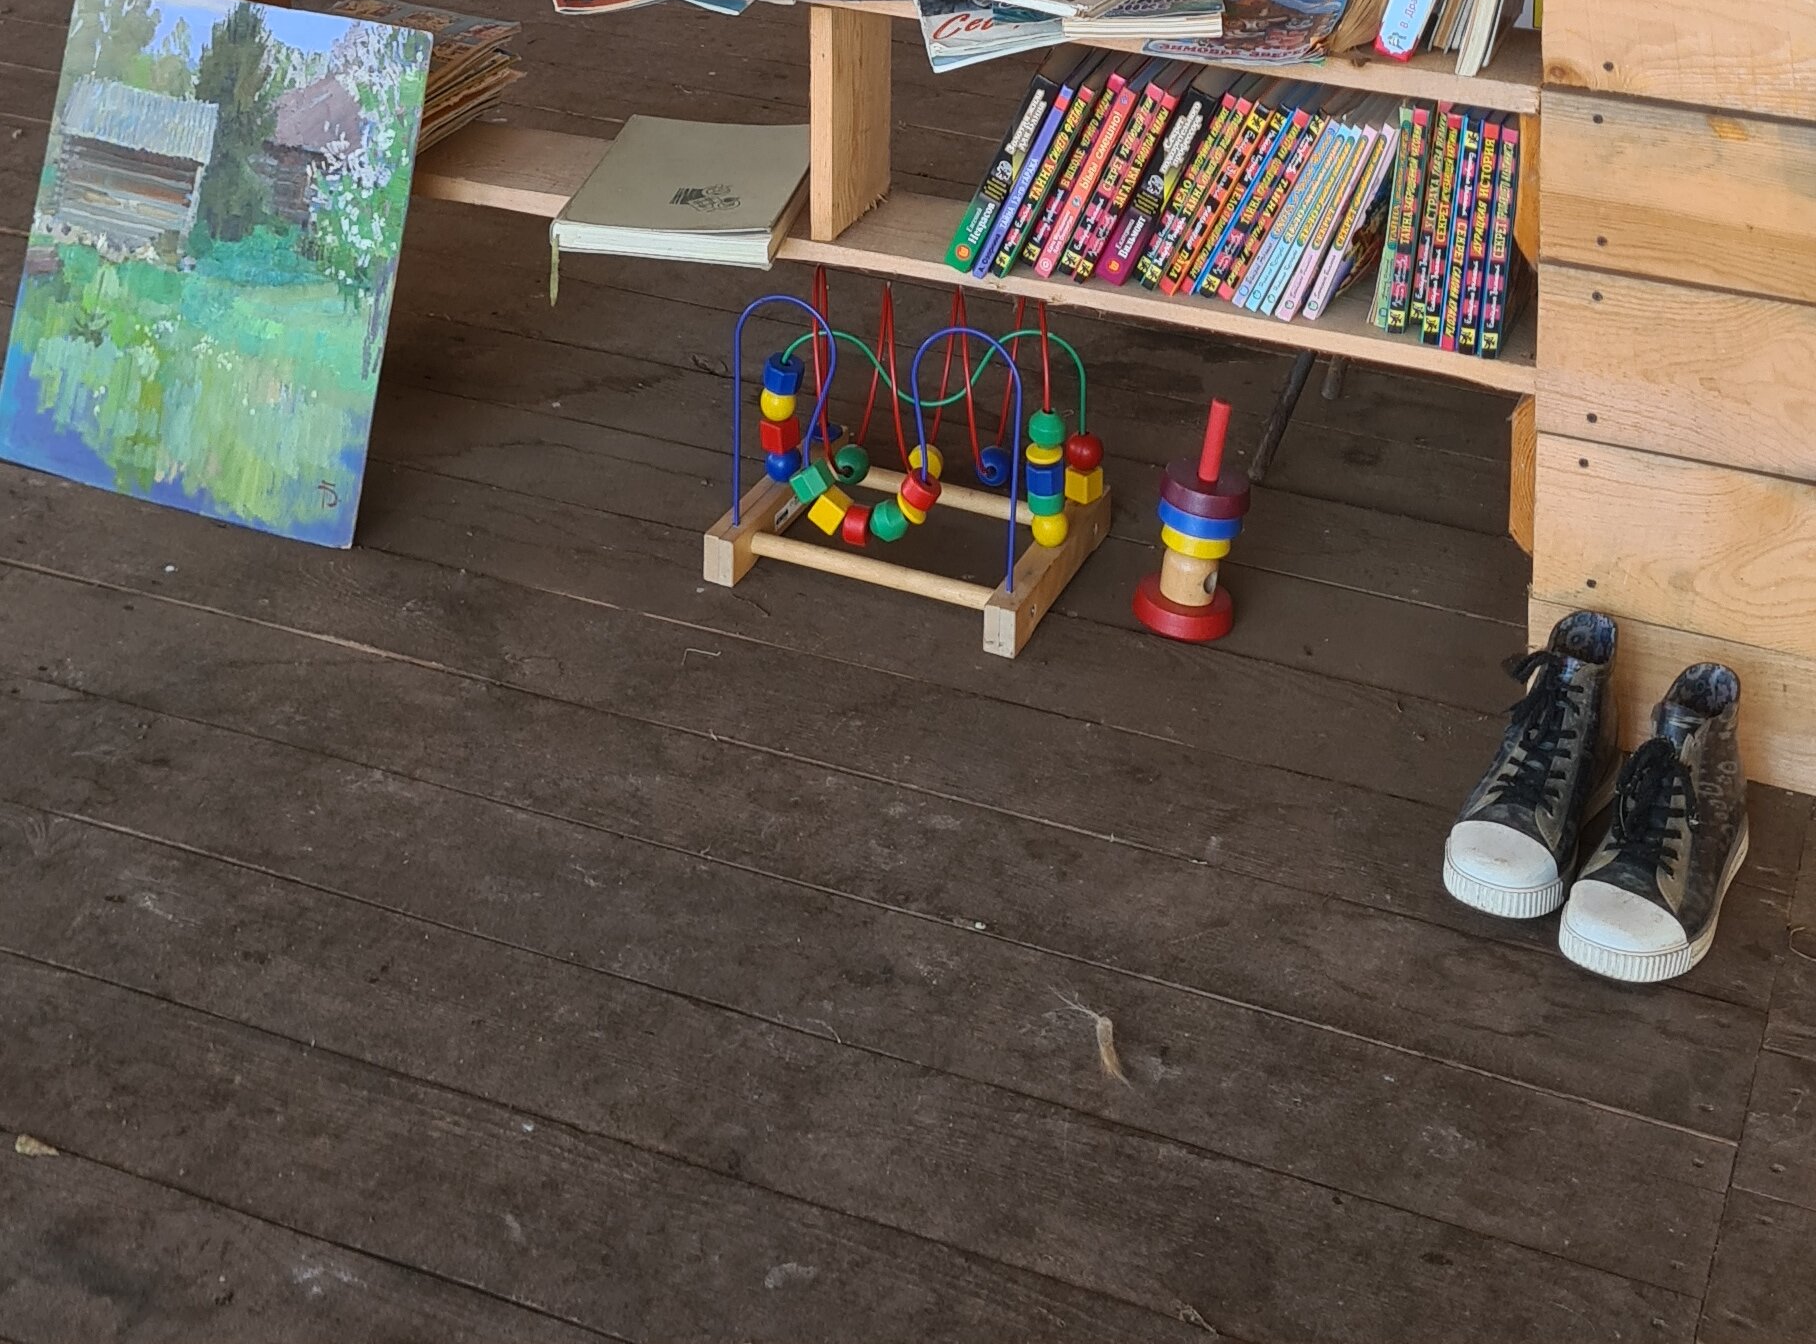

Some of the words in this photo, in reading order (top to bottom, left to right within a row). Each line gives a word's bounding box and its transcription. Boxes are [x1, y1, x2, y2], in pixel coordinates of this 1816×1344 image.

[1028, 161, 1053, 201] ТАЙНА
[1046, 130, 1069, 163] СИНЕГО
[1061, 97, 1086, 134] ФРЕГАТА
[1093, 110, 1122, 160] смешно!
[1063, 147, 1085, 180] ШКОЛЕ
[1102, 157, 1124, 192] СЕКРЕТ
[1477, 137, 1495, 198] ИСТОРИЯ
[1113, 165, 1140, 208] ЗАГАДКА
[1170, 178, 1192, 211] ДЕЛО
[1182, 182, 1205, 217] ТАЙНА
[1262, 177, 1290, 219] ТАЙНА
[1424, 178, 1439, 220] СТРАХА
[966, 206, 982, 232] Евгений
[967, 200, 996, 245] Некрасов
[999, 205, 1015, 229] ТАЙНА
[1114, 217, 1135, 250] Екатерина
[1117, 214, 1145, 259] Вильмонт
[1399, 210, 1412, 244] ТАЙНА
[1435, 202, 1449, 243] СЕКРЕТ
[1471, 200, 1487, 255] ДУРАЦКАЯ
[1453, 221, 1466, 263] СЕКРЕТ
[1493, 222, 1507, 259] СЕКРЕТ
[1169, 248, 1191, 279] ПАПА
